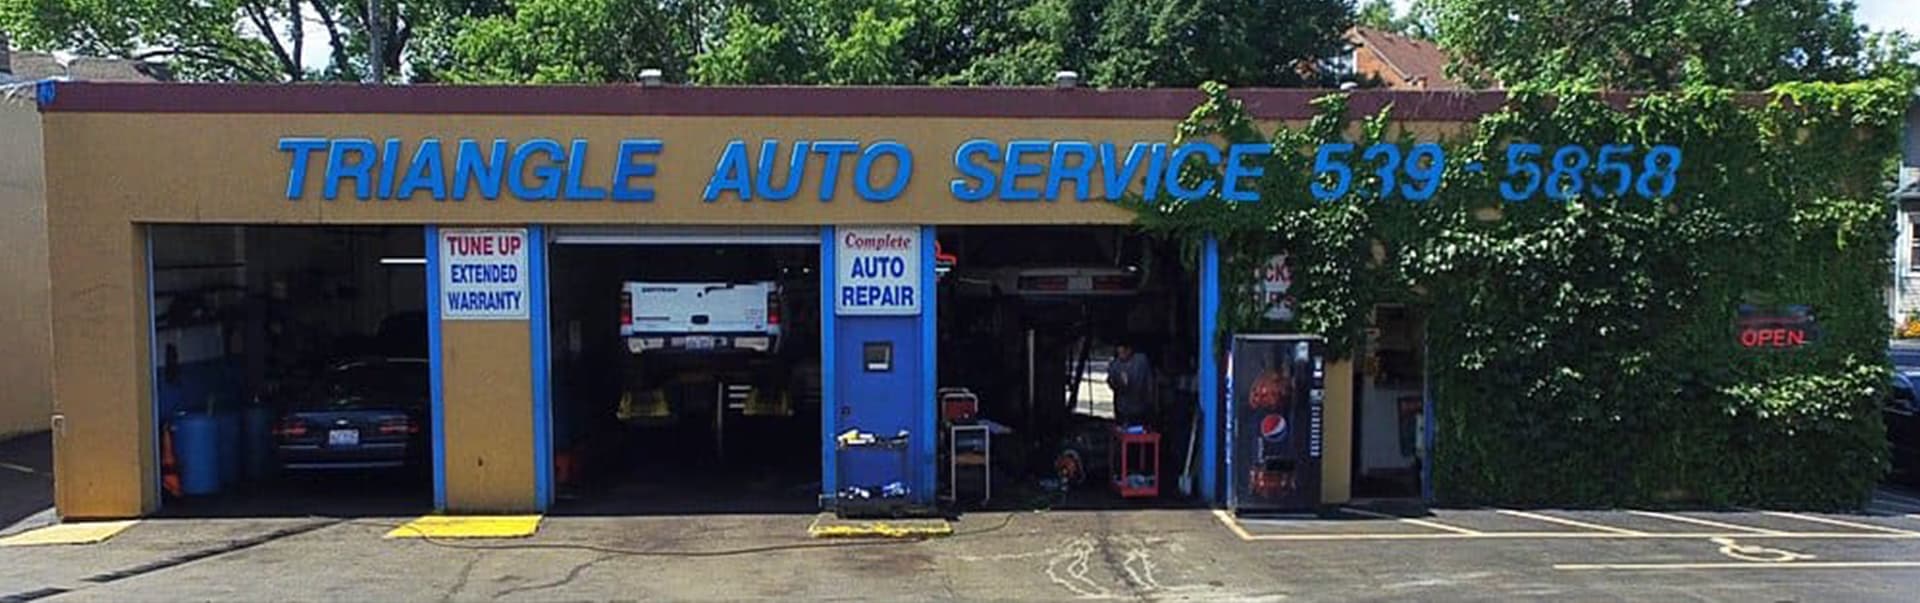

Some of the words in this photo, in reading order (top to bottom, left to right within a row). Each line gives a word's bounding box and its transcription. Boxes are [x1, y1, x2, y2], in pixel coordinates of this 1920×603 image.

[279, 138, 663, 202] TRIANGLE
[703, 139, 914, 202] AUTO
[951, 140, 1273, 203] SERVICE
[447, 236, 493, 255] TUNE
[498, 236, 521, 255] UP
[845, 232, 911, 250] Complete
[450, 264, 518, 283] EXTENDED
[851, 256, 905, 278] AUTO
[447, 291, 521, 311] WARRANTY
[842, 285, 914, 307] REPAIR
[1741, 328, 1805, 347] OPEN
